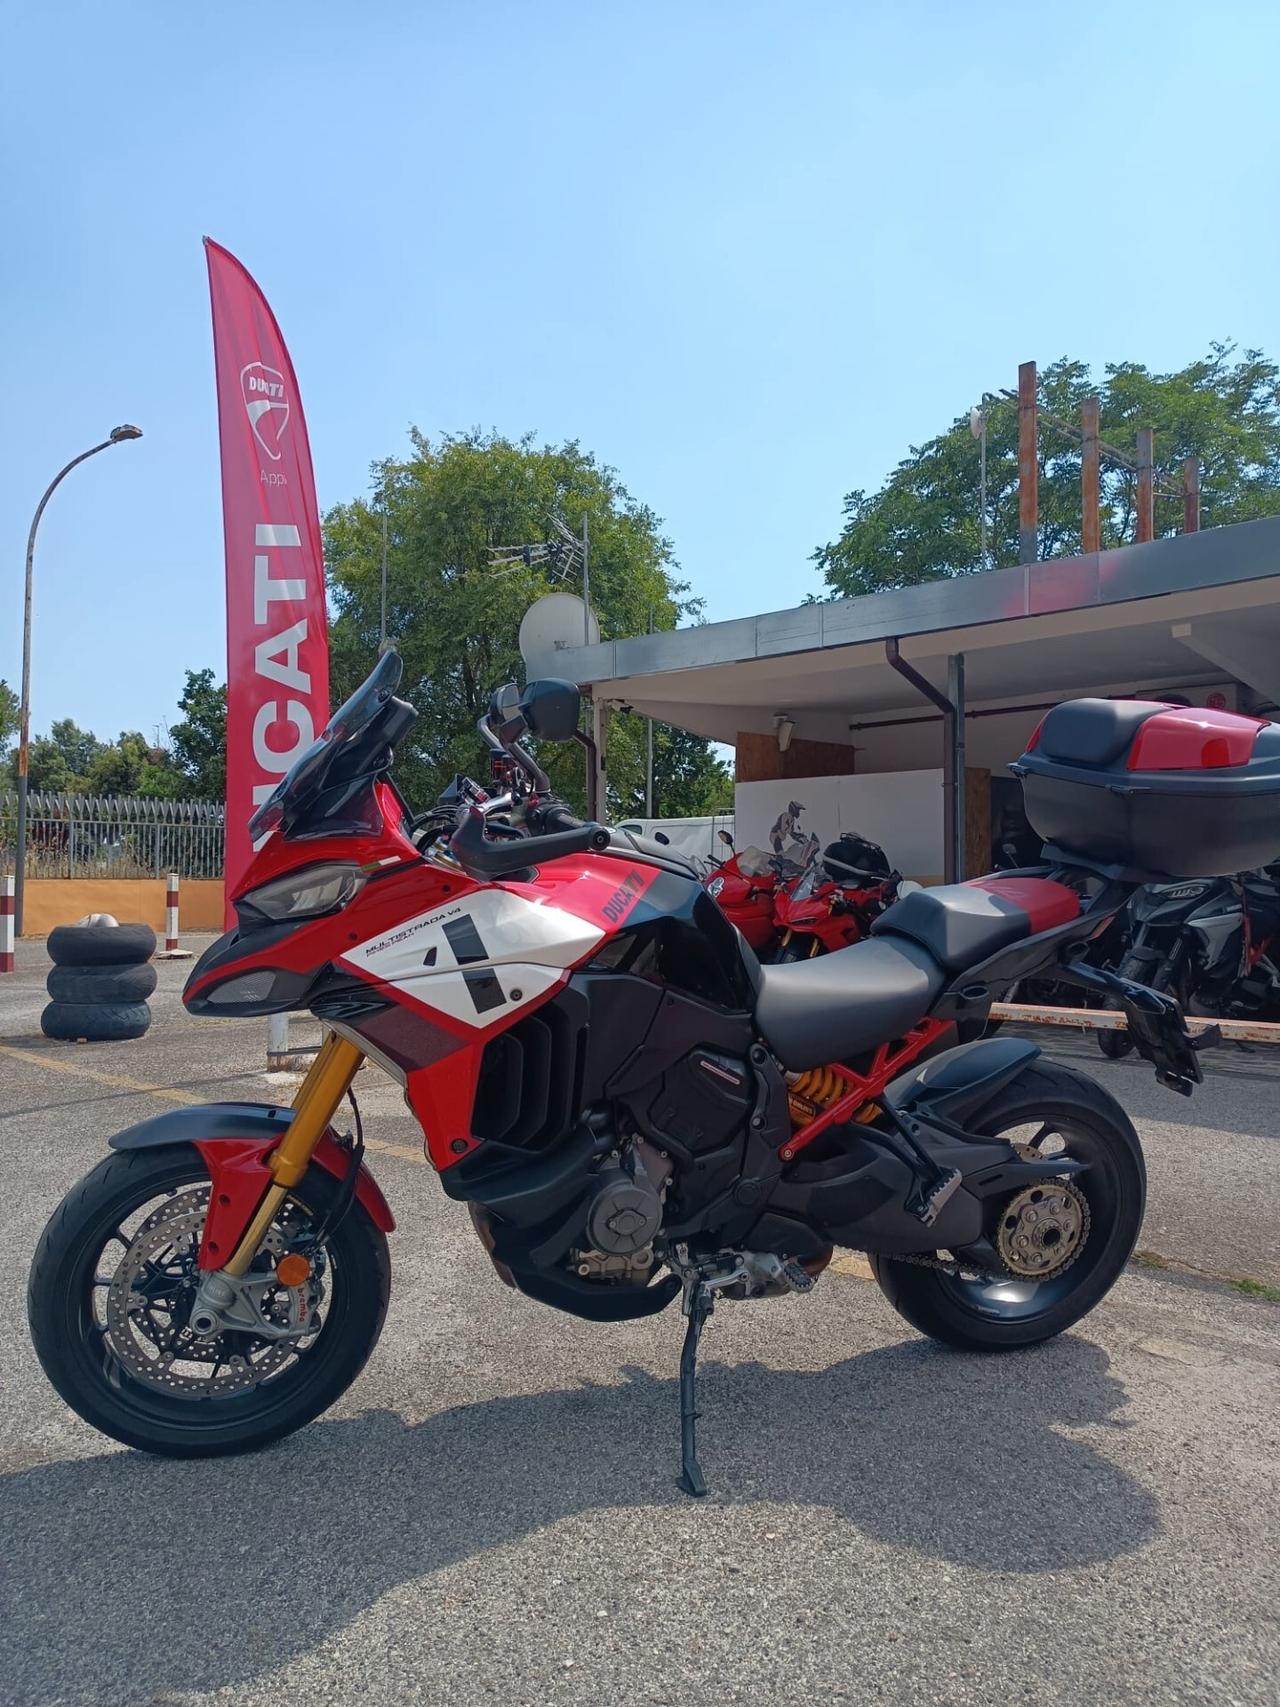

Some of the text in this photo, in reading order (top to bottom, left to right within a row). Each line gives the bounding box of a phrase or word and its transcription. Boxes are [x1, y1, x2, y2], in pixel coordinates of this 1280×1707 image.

[602, 869, 645, 923] DUCATI
[365, 914, 446, 954] MULTISTRADA
[447, 907, 462, 916] V4
[297, 1287, 307, 1322] brembo
